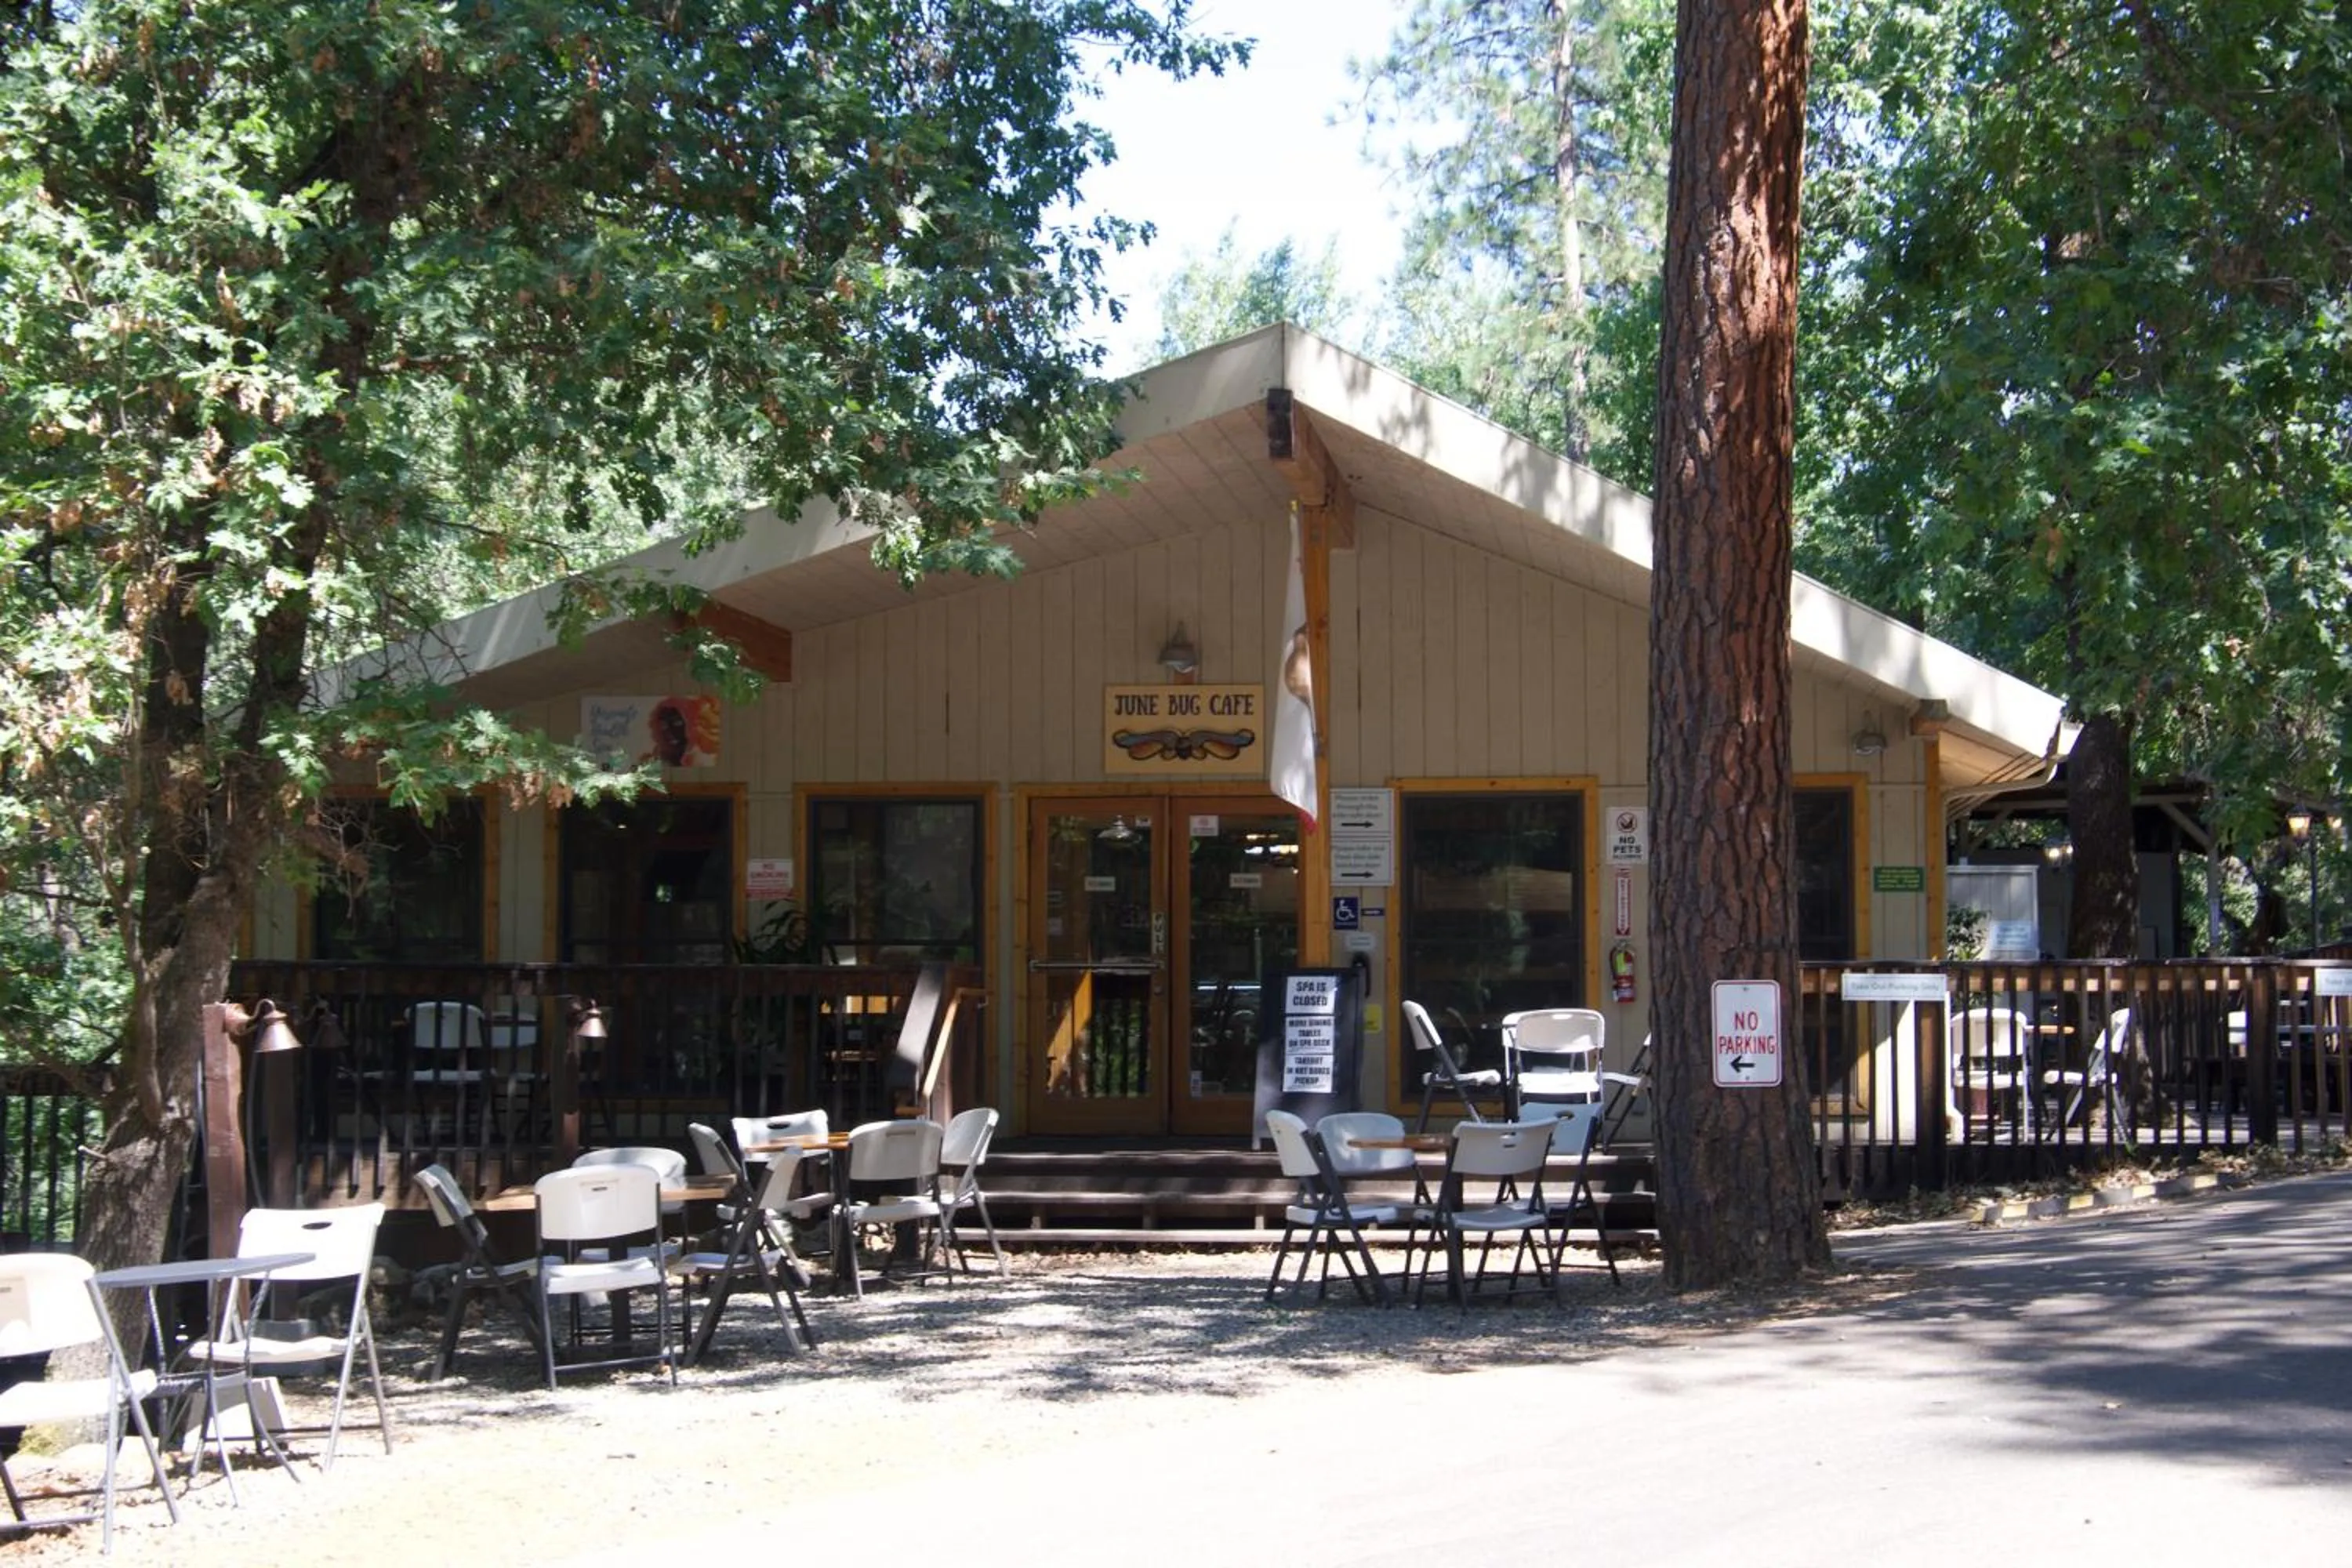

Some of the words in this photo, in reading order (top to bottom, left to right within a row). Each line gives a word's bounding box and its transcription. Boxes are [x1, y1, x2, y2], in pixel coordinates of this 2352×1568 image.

[1114, 694, 1160, 716] JUNE
[1167, 694, 1201, 716] BUG
[1209, 694, 1254, 716] CAFE
[1619, 836, 1635, 844] NO
[1613, 845, 1642, 854] PETS
[1296, 981, 1315, 993] SPA
[1316, 981, 1327, 992] IS
[1293, 995, 1328, 1007] CLOSED
[1734, 1011, 1759, 1031] NO
[1718, 1036, 1776, 1054] PARKING
